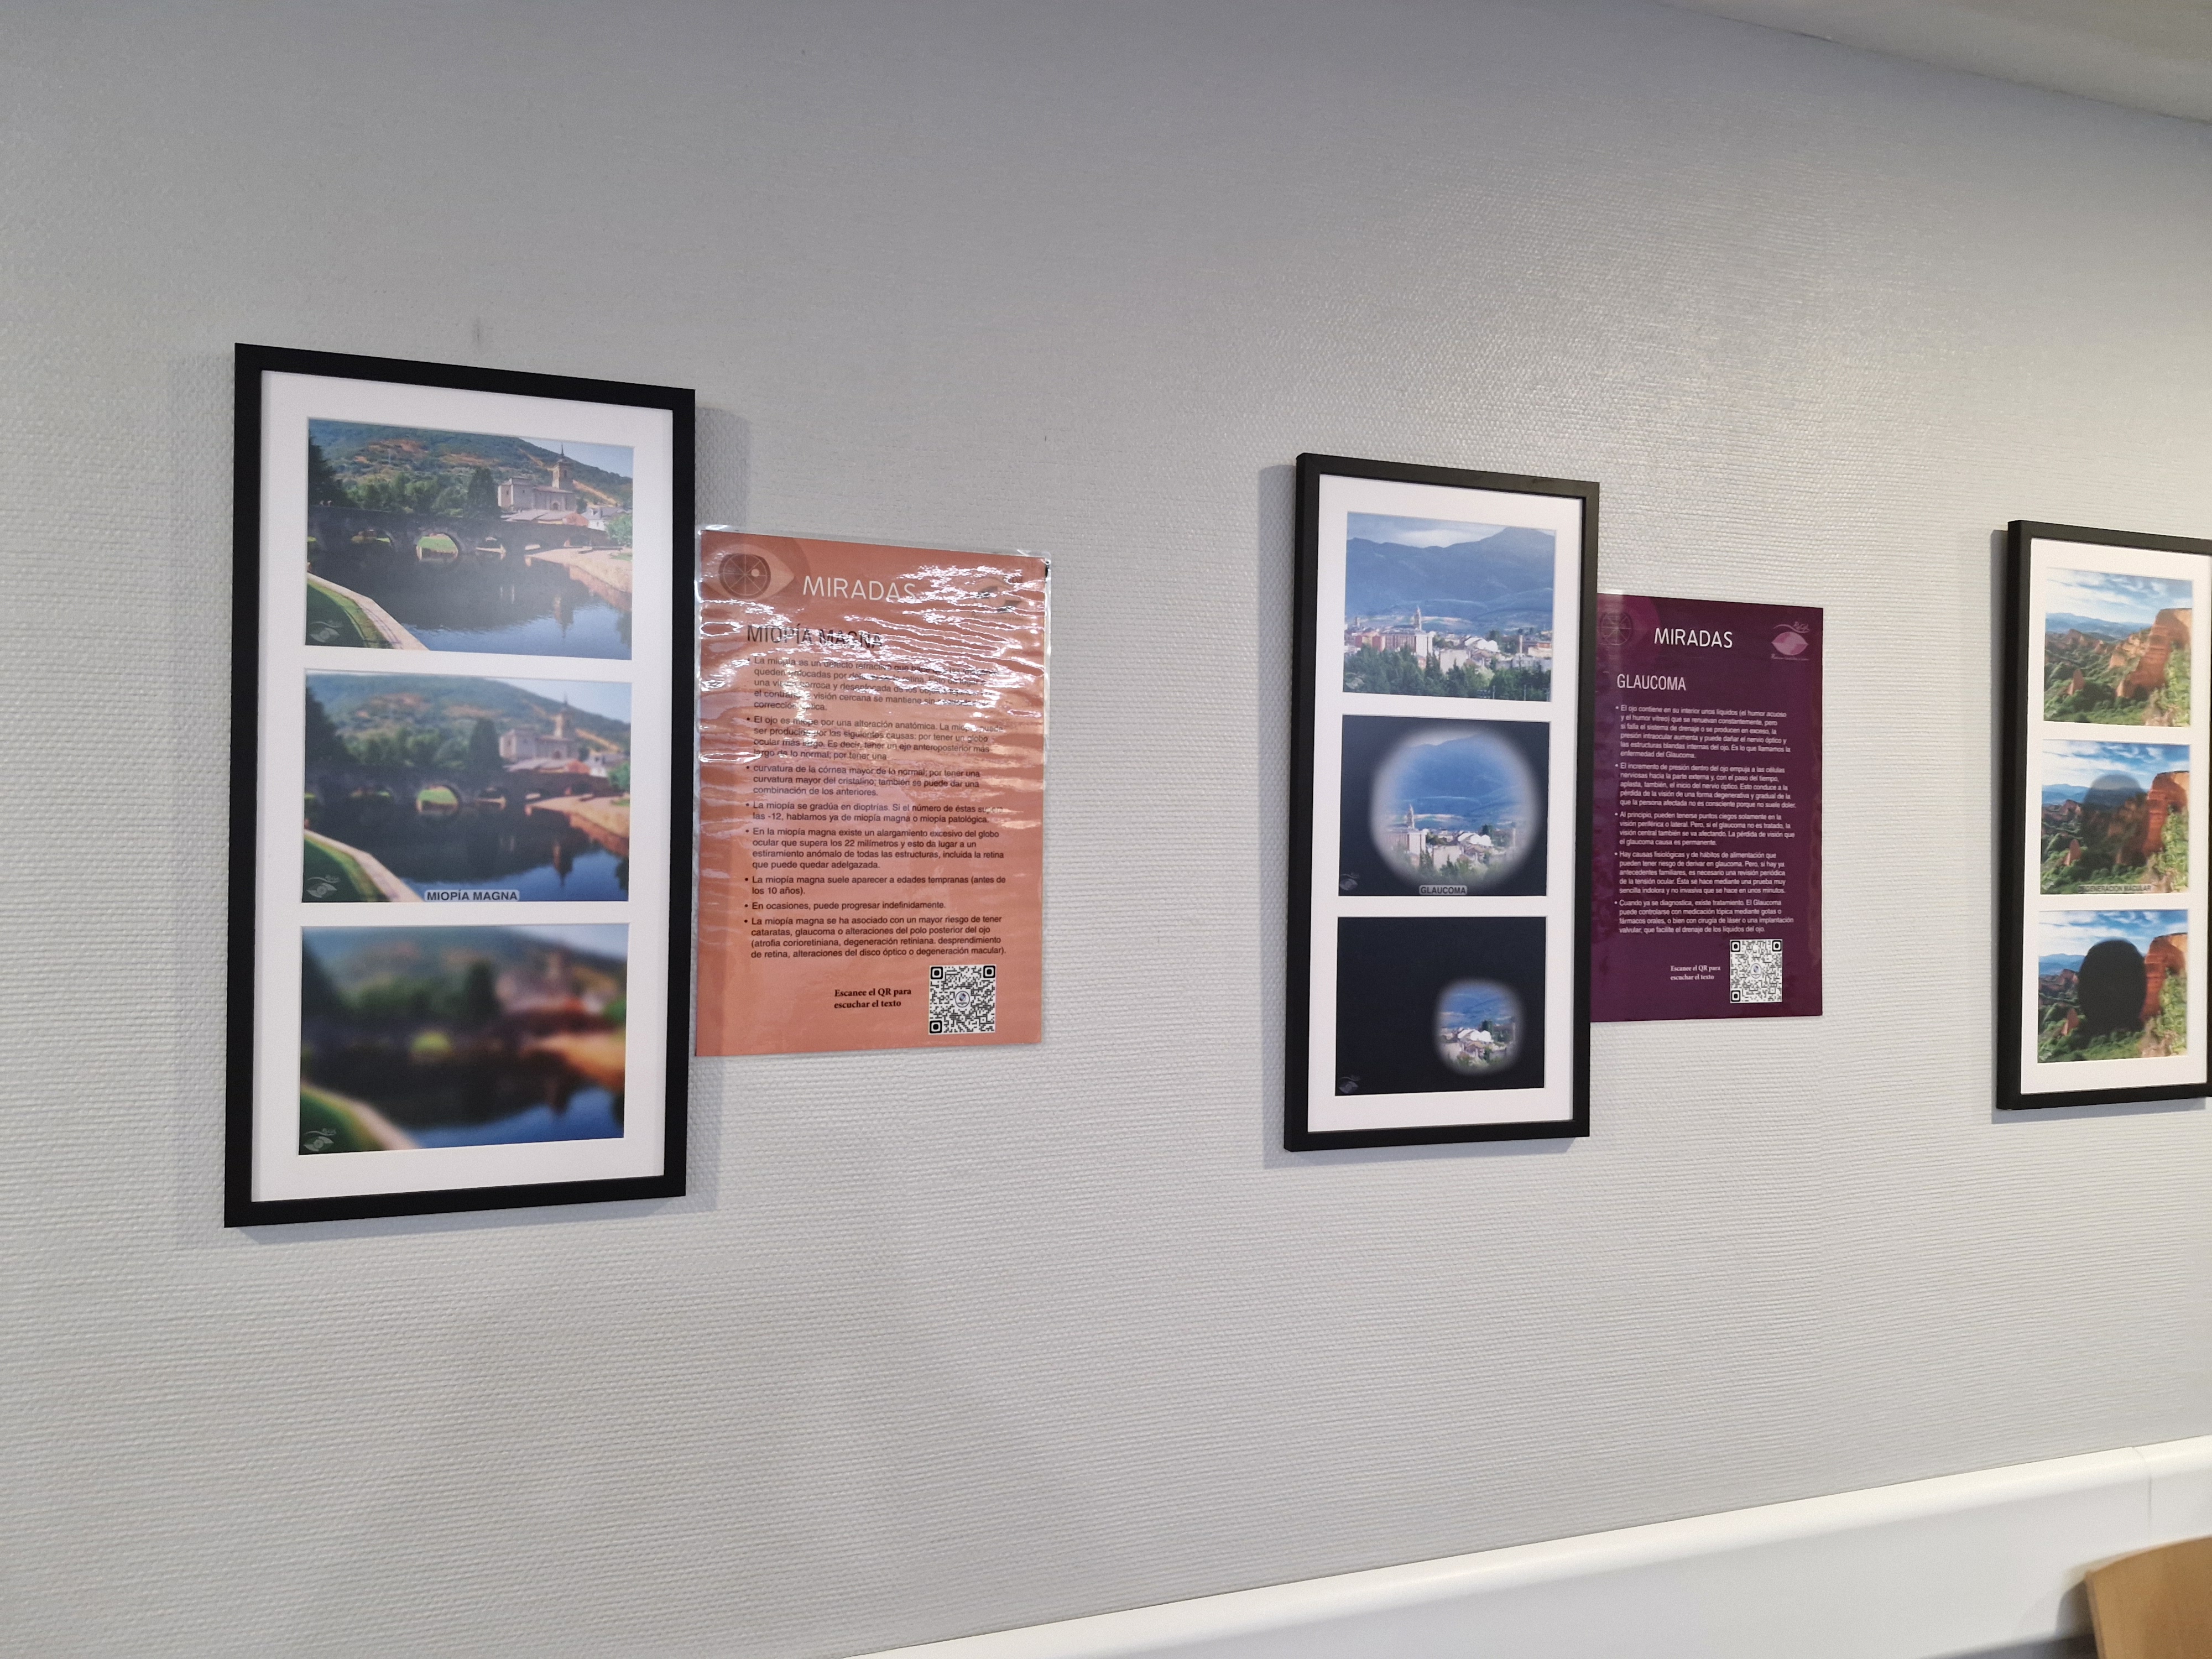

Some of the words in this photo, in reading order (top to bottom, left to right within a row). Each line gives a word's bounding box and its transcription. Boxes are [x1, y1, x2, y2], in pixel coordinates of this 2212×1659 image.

[803, 576, 916, 602] MIRADAS
[748, 623, 812, 644] MIOPÍA
[1654, 628, 1733, 648] MIRADAS
[1616, 674, 1687, 691] GLAUCOMA
[753, 786, 806, 794] combinación
[836, 787, 878, 796] anteriores.
[766, 801, 795, 811] miopía
[809, 802, 838, 812] gradúa
[853, 803, 889, 812] dioptrías.
[912, 804, 941, 812] número
[768, 812, 783, 821] -12,
[854, 814, 880, 823] miopía
[920, 815, 946, 824] miopía
[948, 814, 989, 825] patológica.
[771, 860, 797, 869] puede
[799, 860, 829, 870] quedar
[831, 861, 880, 870] adelgazada.
[765, 875, 794, 884] miopía
[928, 876, 968, 884] tempranas
[971, 876, 994, 884] (antes
[427, 890, 469, 901] MIOPÍA
[473, 891, 518, 901] MAGNA
[779, 886, 805, 896] años).
[765, 901, 811, 910] ocasiones,
[813, 901, 839, 911] puede
[764, 917, 793, 926] miopía
[945, 915, 969, 925] riesgo
[751, 928, 792, 936] cataratas,
[795, 927, 835, 937] glaucoma
[928, 926, 963, 935] posterior
[978, 926, 990, 935] ojo
[751, 939, 780, 948] (atrofia
[782, 938, 841, 947] corioretiniana,
[843, 937, 898, 947] degeneración
[937, 936, 1001, 945] desprendimiento
[764, 950, 790, 958] retina,
[792, 949, 843, 957] alteraciones
[883, 948, 906, 957] óptico
[916, 947, 969, 957] degeneración
[971, 946, 1006, 956] macular).
[878, 988, 891, 997] QR
[834, 1000, 870, 1008] escuchar
